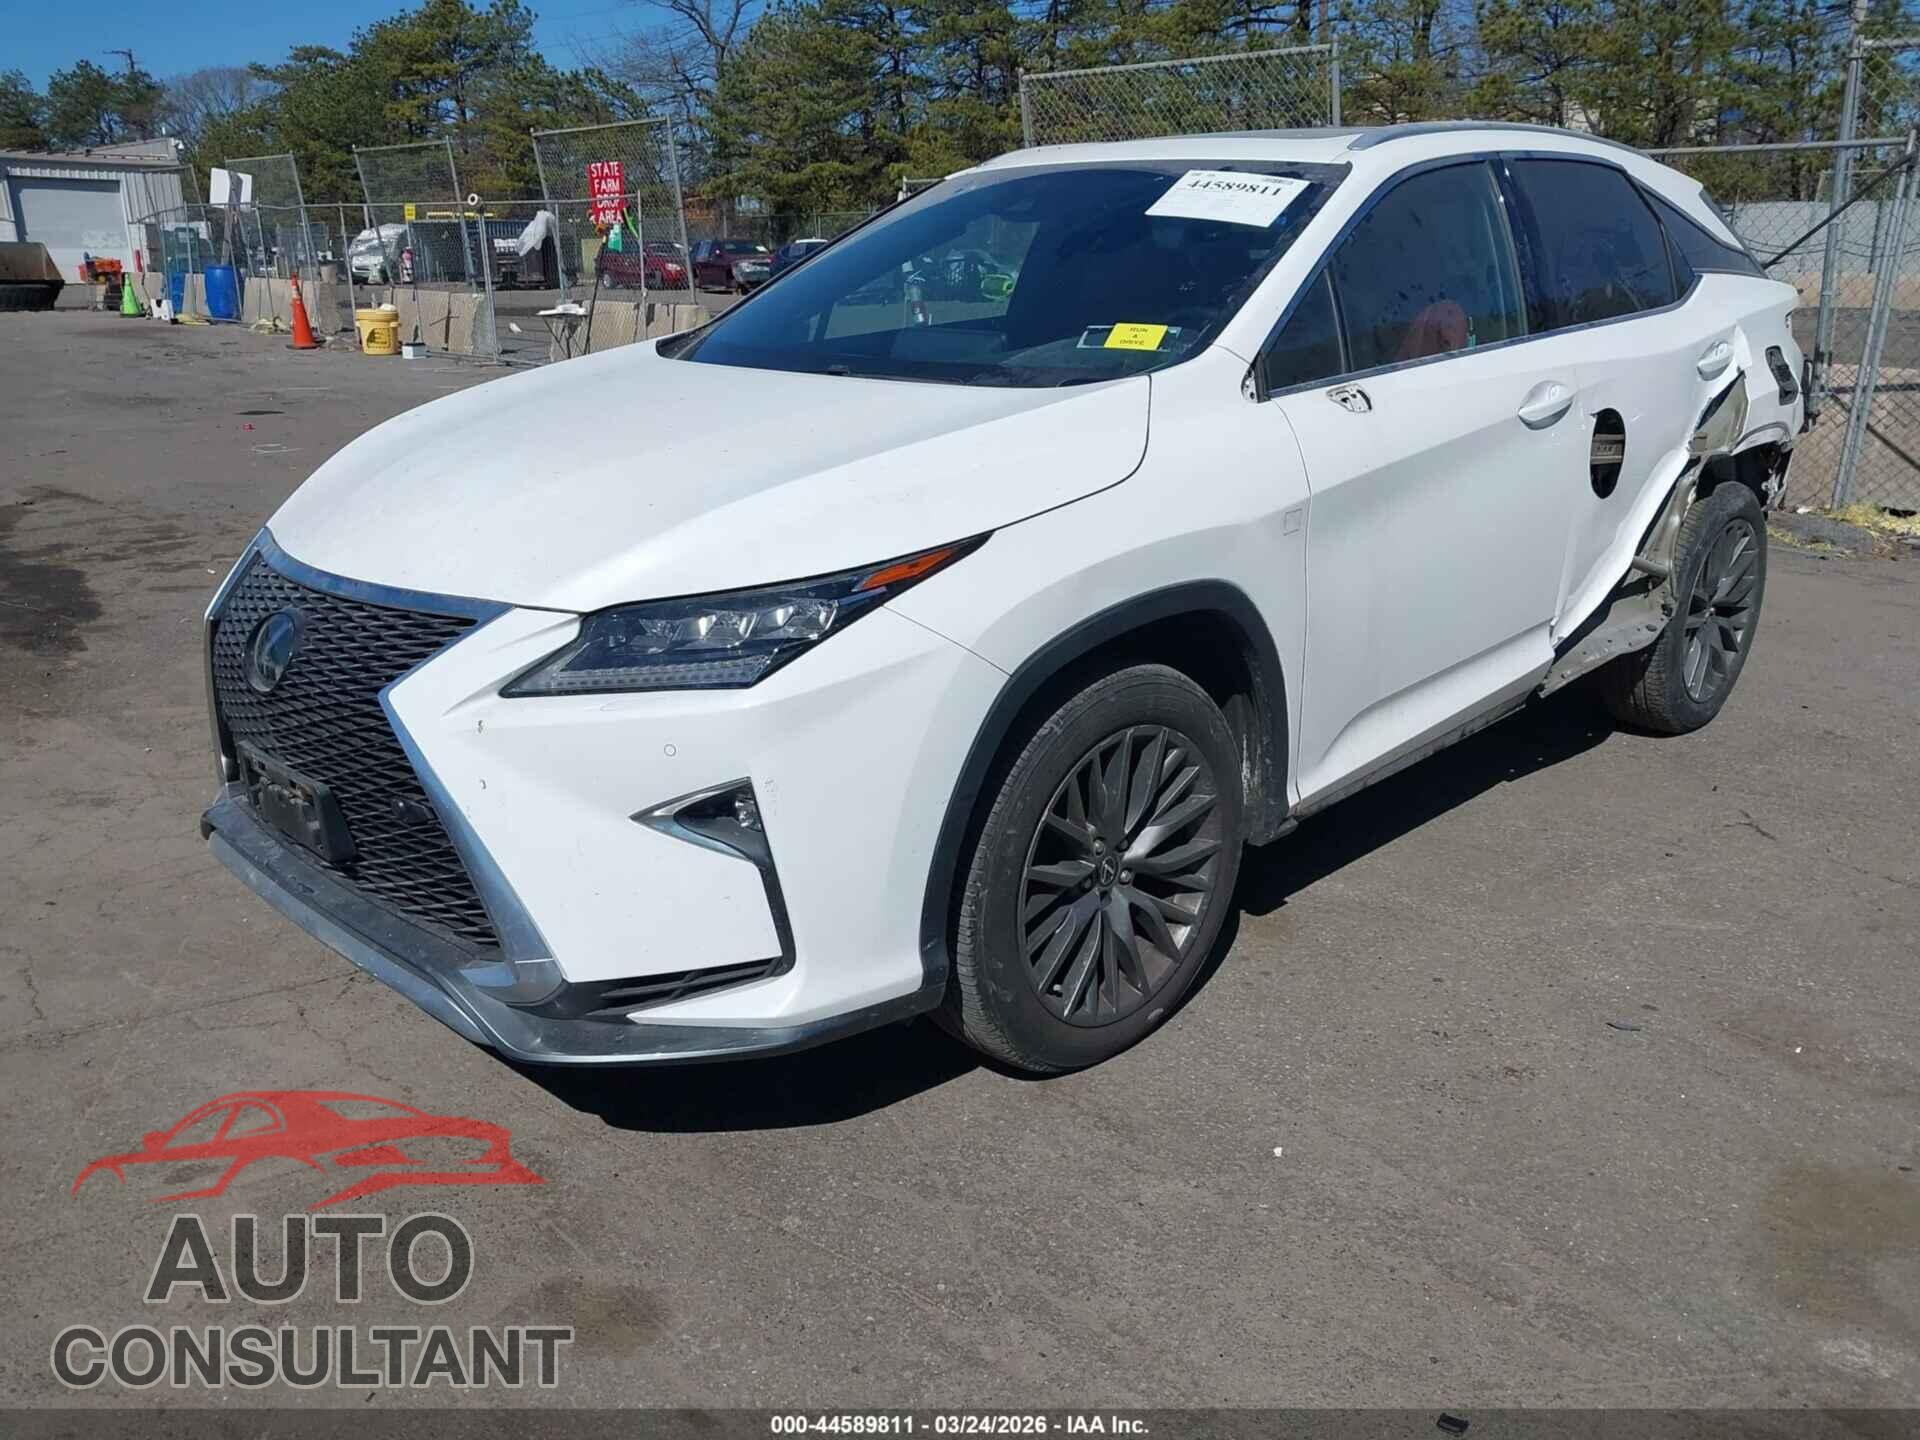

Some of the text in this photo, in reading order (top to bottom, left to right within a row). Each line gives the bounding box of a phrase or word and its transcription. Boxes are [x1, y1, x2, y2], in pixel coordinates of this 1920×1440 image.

[590, 161, 620, 178] STATE
[594, 179, 620, 193] FARM
[1188, 180, 1282, 196] 44589811
[599, 210, 624, 225] AREA
